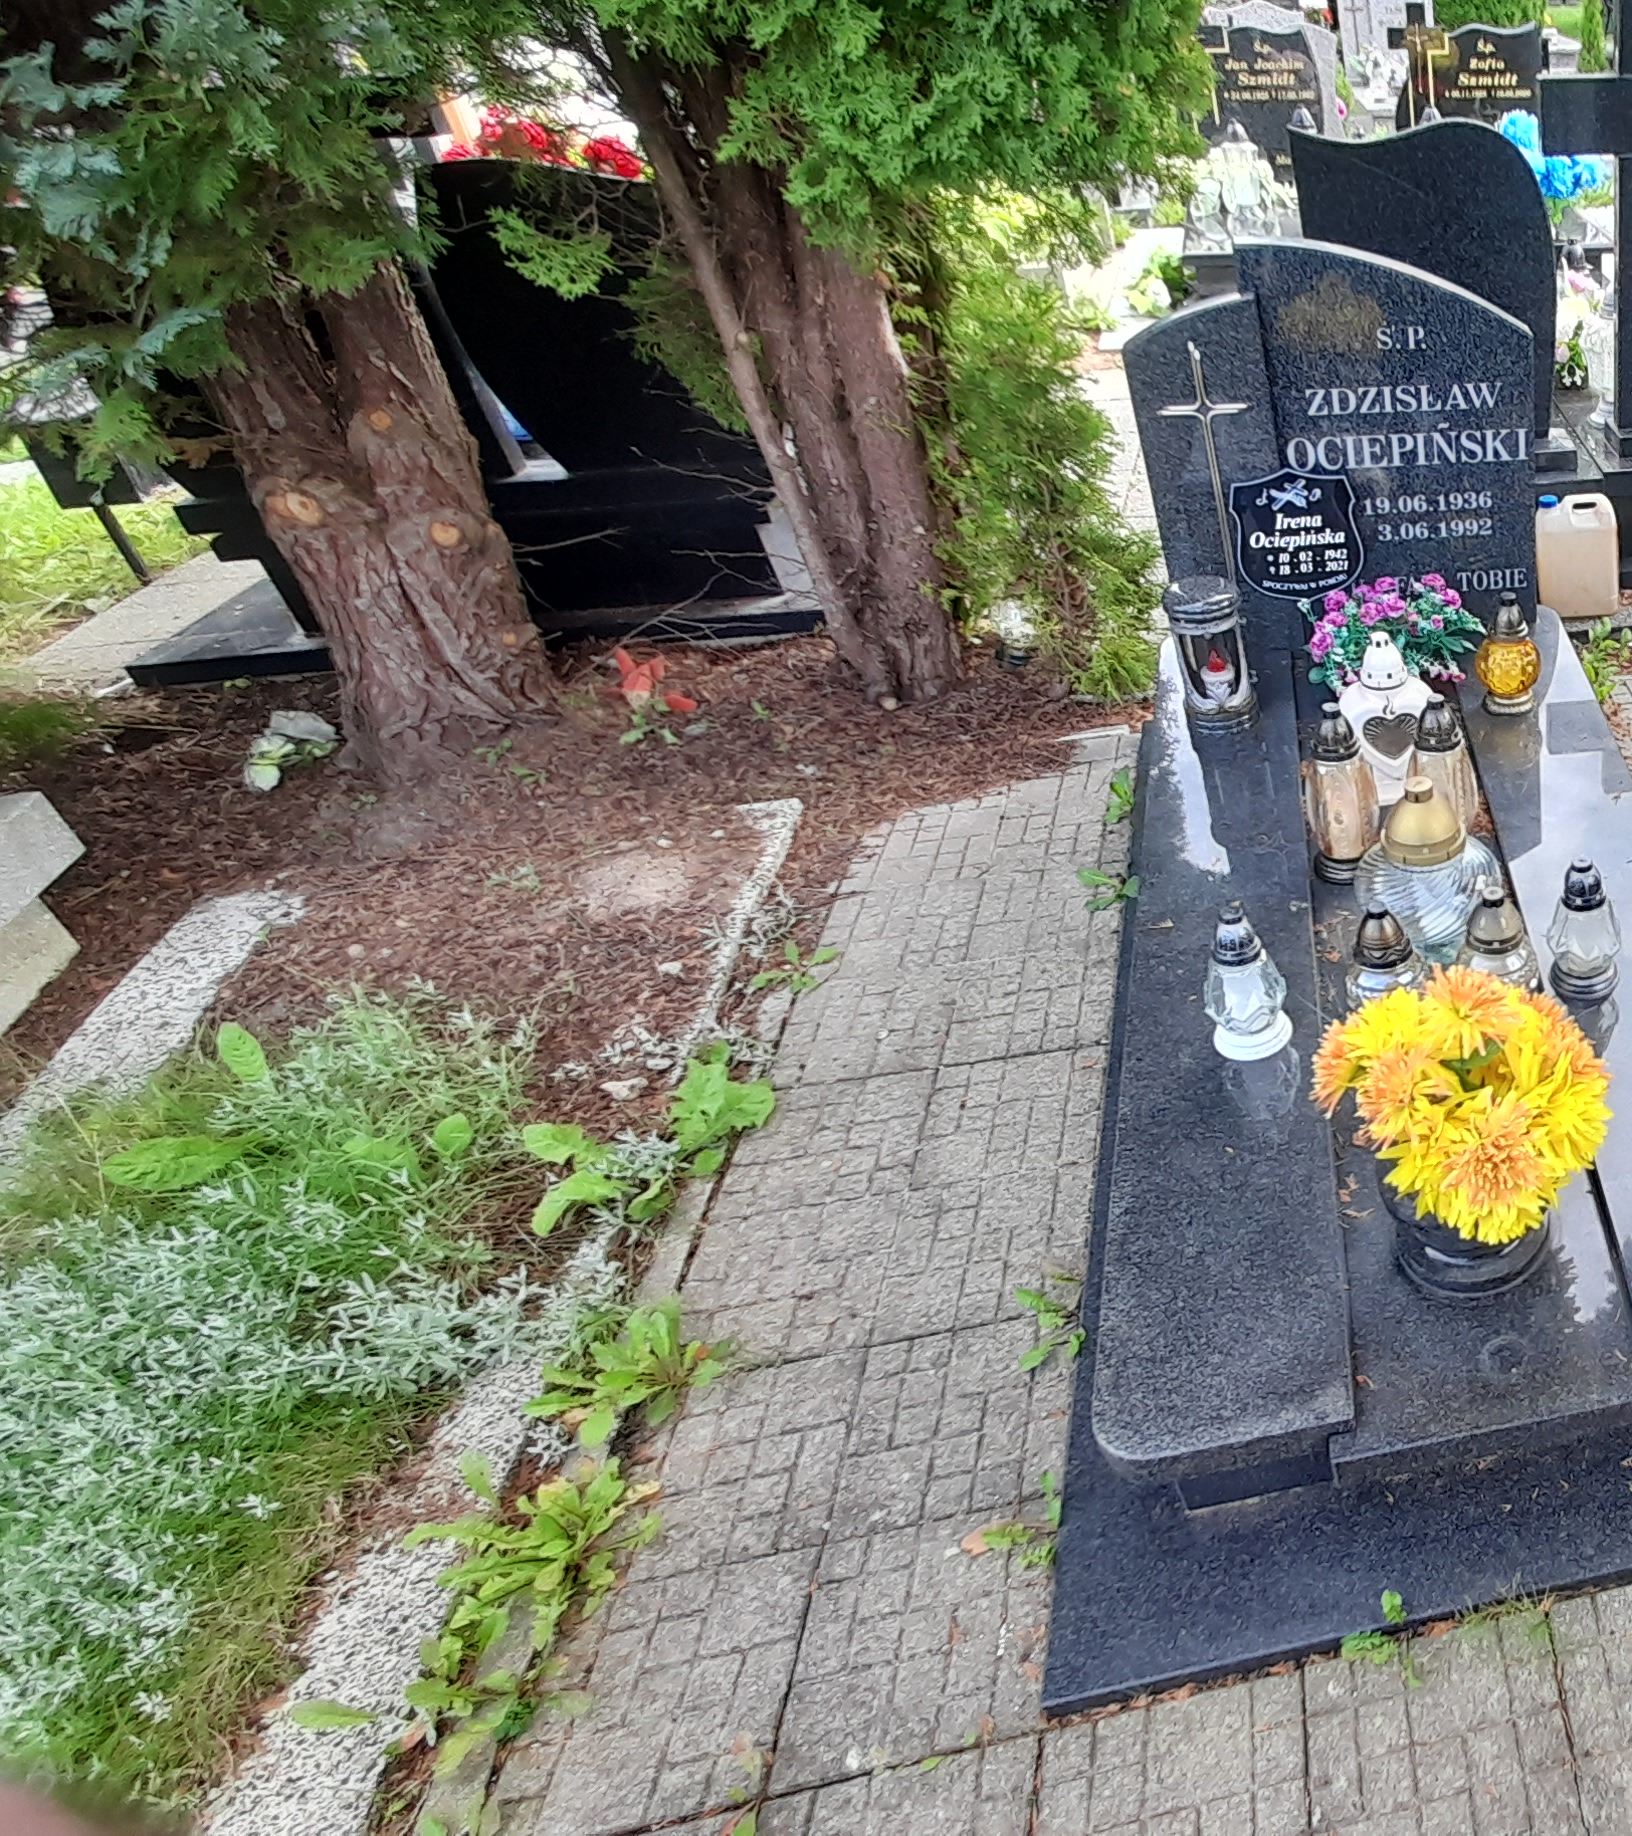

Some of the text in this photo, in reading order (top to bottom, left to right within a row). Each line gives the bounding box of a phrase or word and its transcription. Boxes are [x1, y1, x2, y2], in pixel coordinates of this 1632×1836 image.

[1225, 57, 1305, 70] Jan Joachim
[1237, 71, 1297, 86] Szmidt
[1457, 71, 1519, 87] Szmidt
[1305, 382, 1503, 417] ZDZISŁAW
[1364, 491, 1493, 516] 19.06.1936
[1274, 513, 1323, 530] Irena
[1377, 518, 1493, 541] 3.06.1992
[1249, 528, 1346, 552] Ociepińska
[1457, 568, 1528, 592] TOBIE
